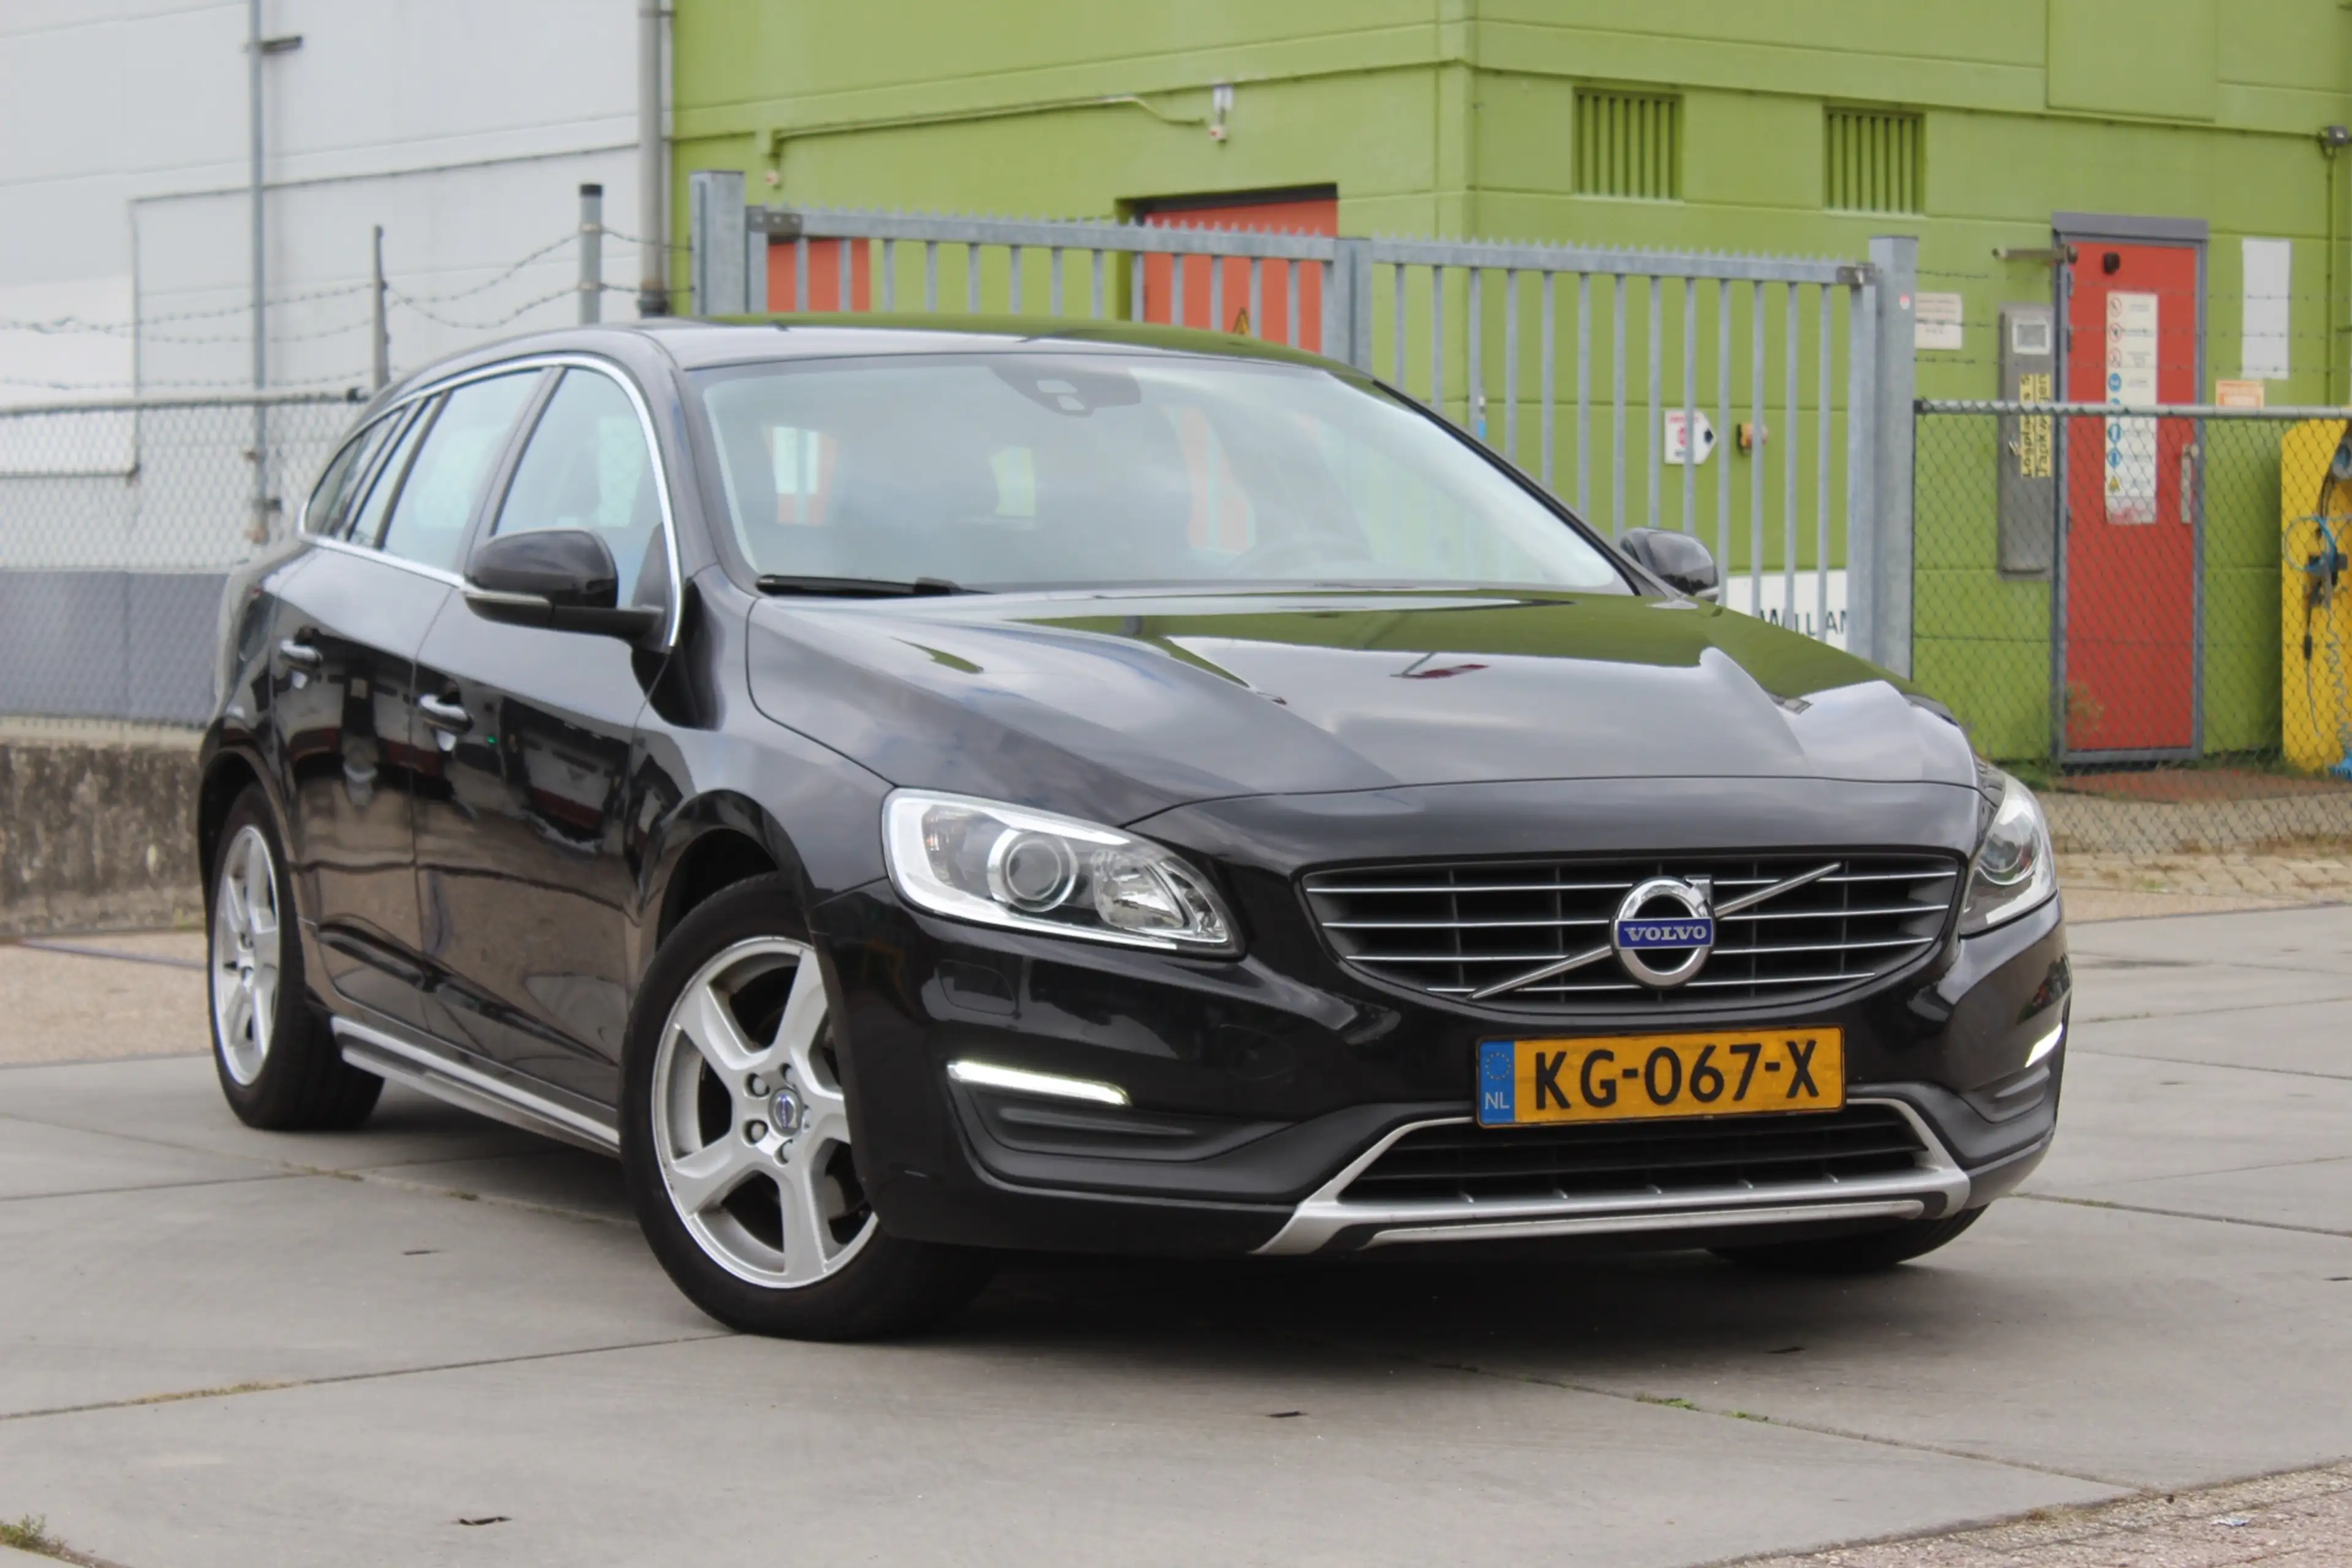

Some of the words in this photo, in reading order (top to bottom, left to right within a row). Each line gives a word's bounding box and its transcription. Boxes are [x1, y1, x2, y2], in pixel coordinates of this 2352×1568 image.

[1624, 925, 1707, 941] VOLVO
[1534, 1040, 1820, 1110] KG-067-X
[1485, 1091, 1510, 1110] NL
